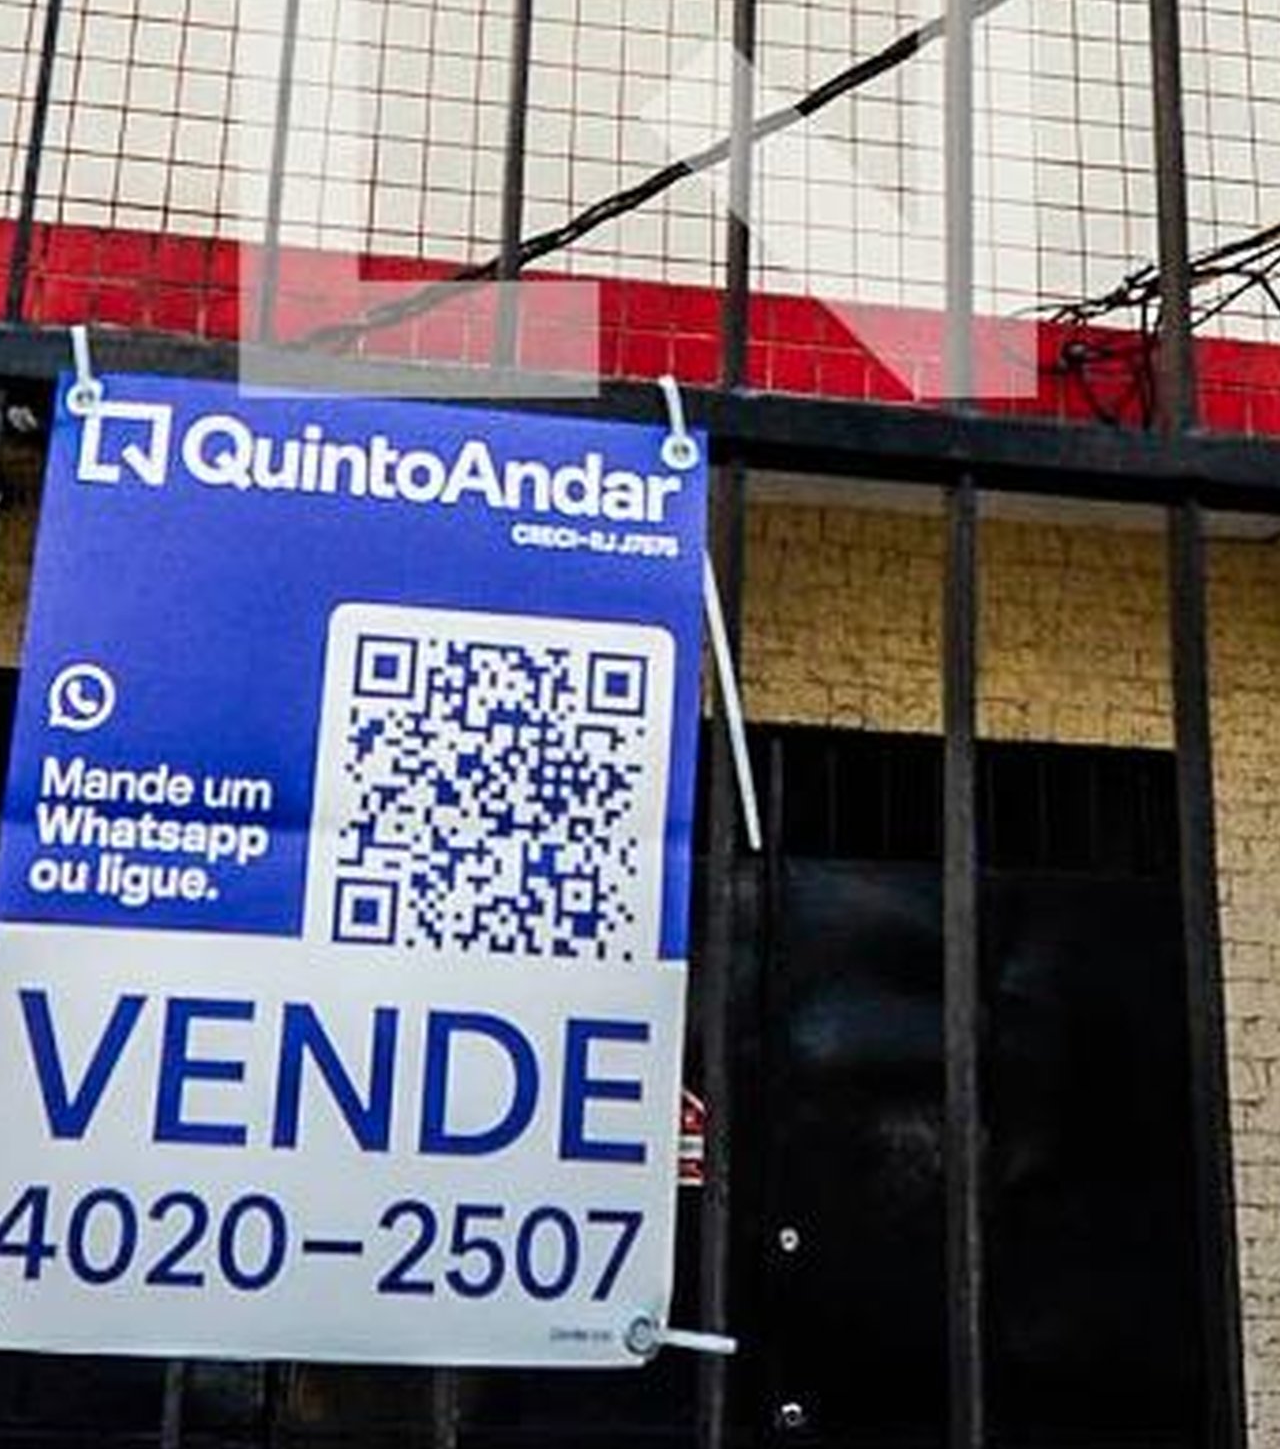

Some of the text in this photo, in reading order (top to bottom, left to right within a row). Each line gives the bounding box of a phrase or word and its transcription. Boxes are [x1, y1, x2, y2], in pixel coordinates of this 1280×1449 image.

[182, 415, 681, 522] QuintoAndar
[42, 756, 273, 810] Mande um
[37, 803, 268, 865] Whatsapp
[30, 853, 218, 905] ou ligue.
[18, 989, 651, 1165] VENDE
